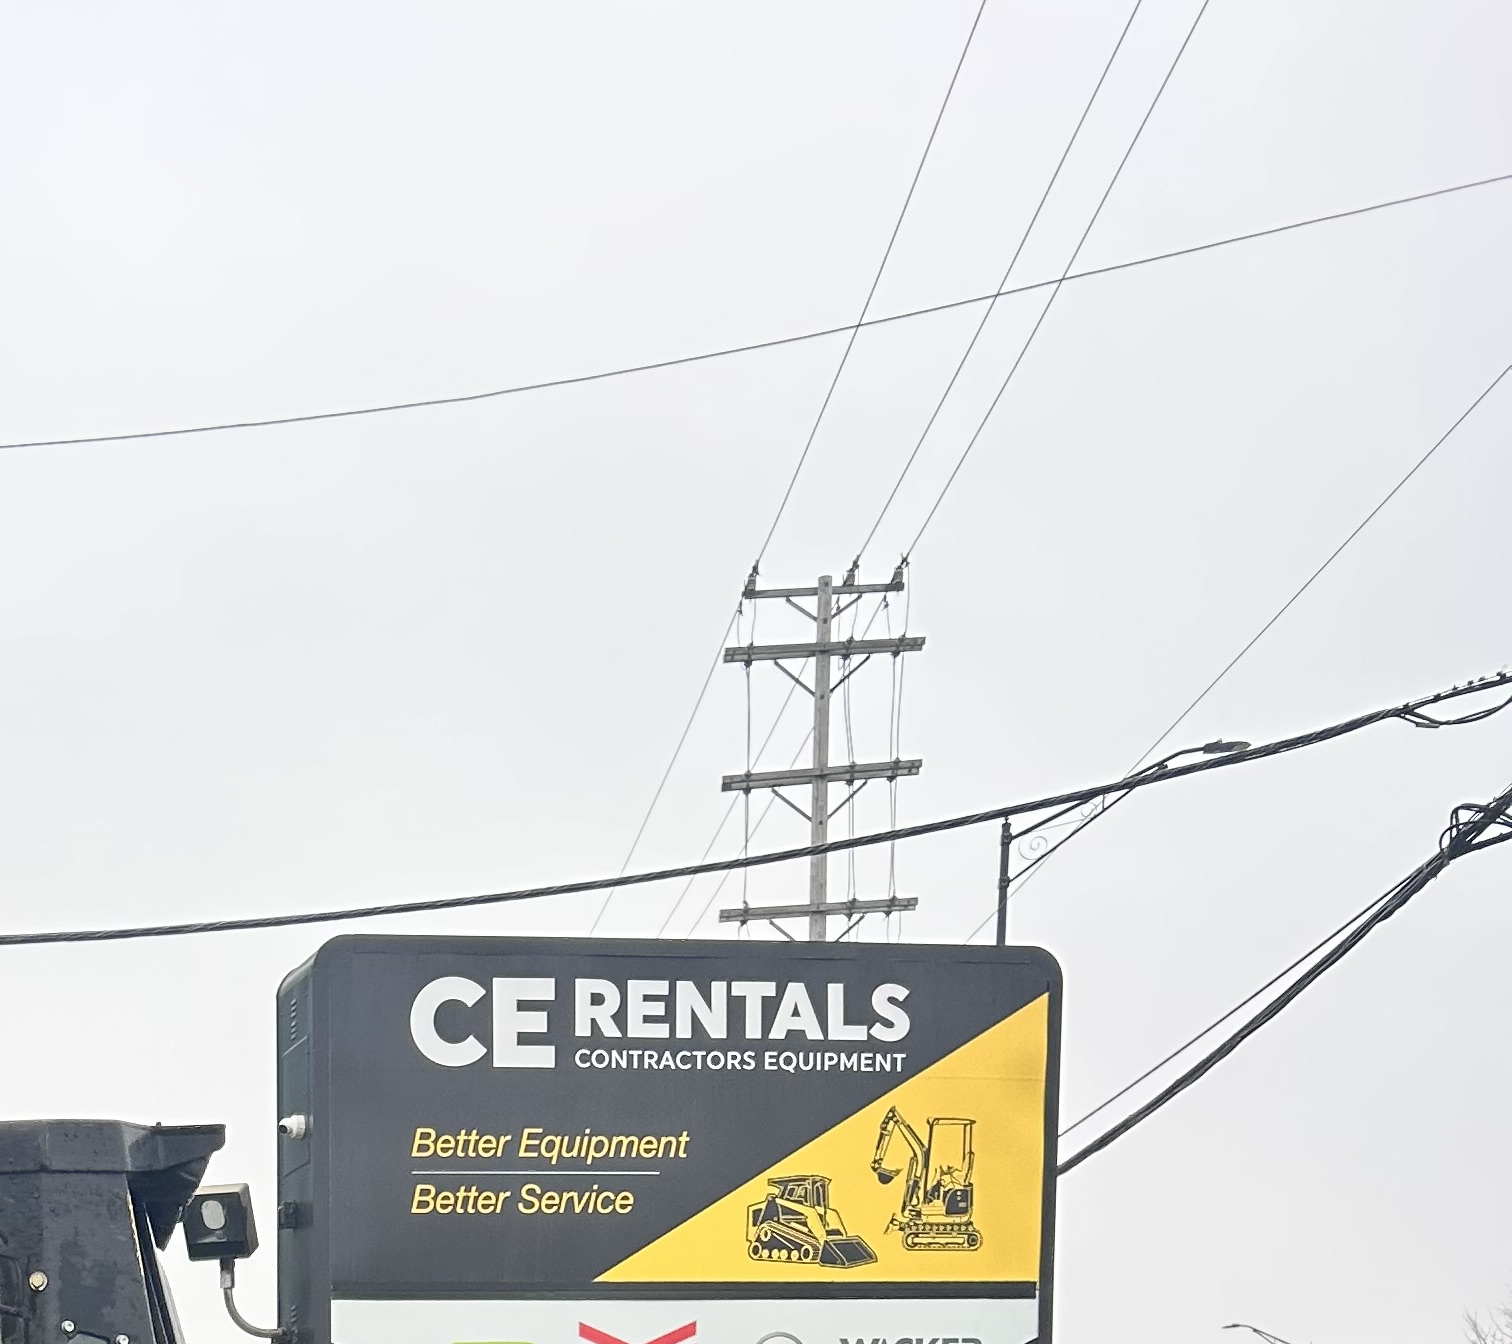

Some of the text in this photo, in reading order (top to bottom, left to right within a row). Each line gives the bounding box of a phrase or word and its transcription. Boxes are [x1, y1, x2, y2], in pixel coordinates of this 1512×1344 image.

[410, 976, 911, 1068] CE RENTALS
[574, 1048, 907, 1073] CONTRACTORS EQUIPMENT
[410, 1127, 690, 1165] Better Equipment
[410, 1183, 634, 1214] Better Service
